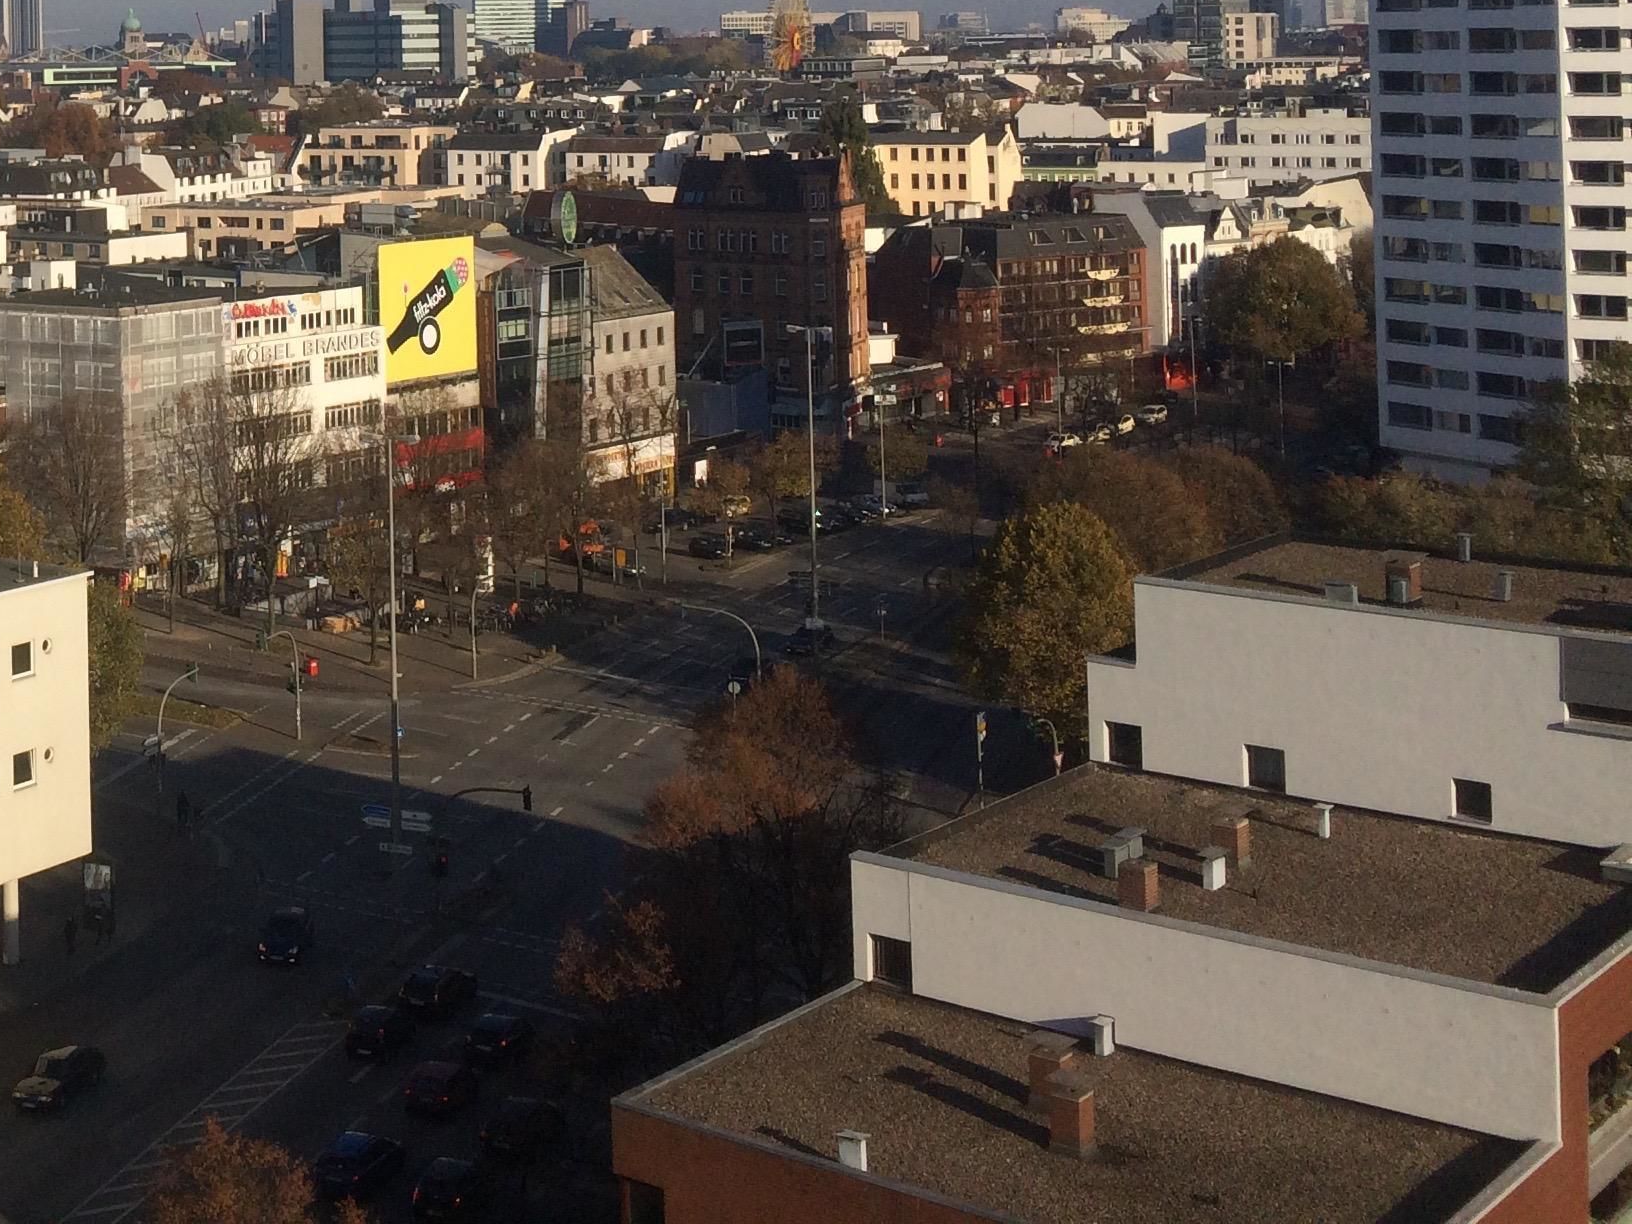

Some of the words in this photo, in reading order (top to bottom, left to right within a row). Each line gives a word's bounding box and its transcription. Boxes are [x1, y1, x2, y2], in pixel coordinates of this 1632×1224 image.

[412, 284, 447, 323] fritz-kola
[232, 342, 295, 367] MÖBEL
[302, 330, 381, 357] BRANDES
